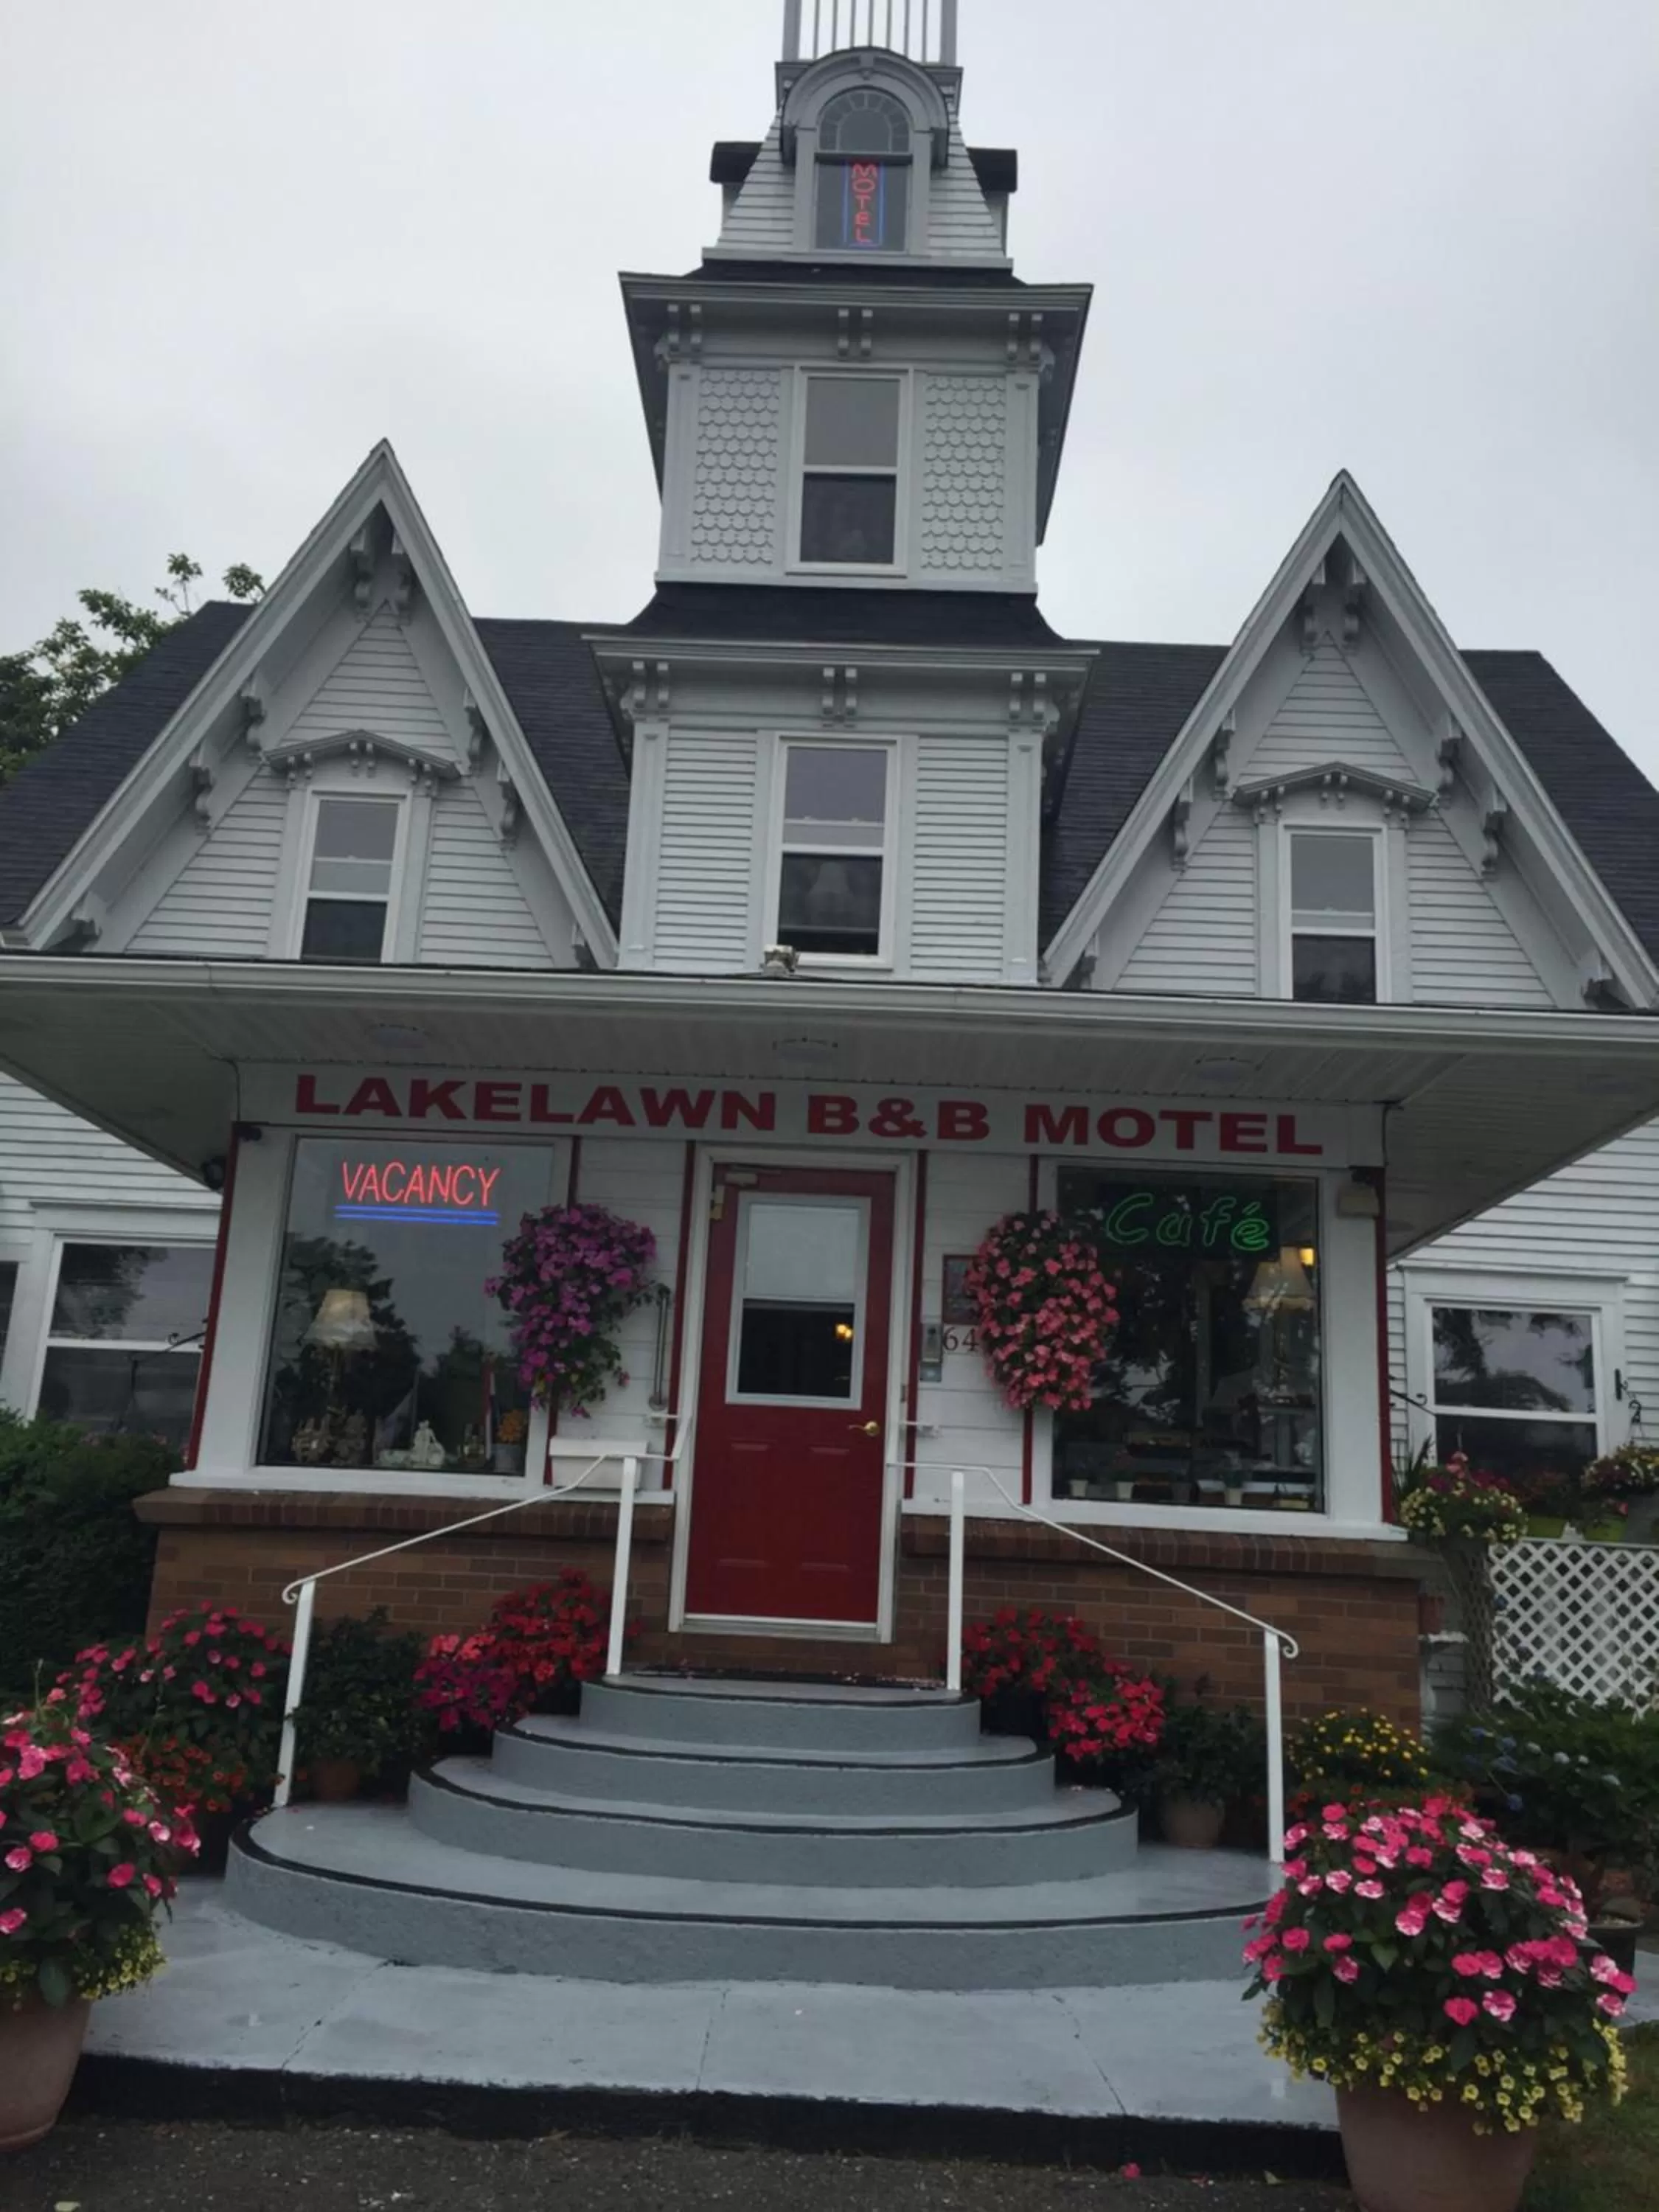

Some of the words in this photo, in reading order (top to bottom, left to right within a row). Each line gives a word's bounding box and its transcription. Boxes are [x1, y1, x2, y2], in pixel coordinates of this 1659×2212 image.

[851, 163, 877, 243] MOTEL
[296, 1074, 776, 1131] LAKELAWN
[807, 1095, 990, 1141] B&B
[1023, 1104, 1323, 1155] MOTEL
[341, 1161, 501, 1207] VACANCY
[1107, 1192, 1270, 1251] Café
